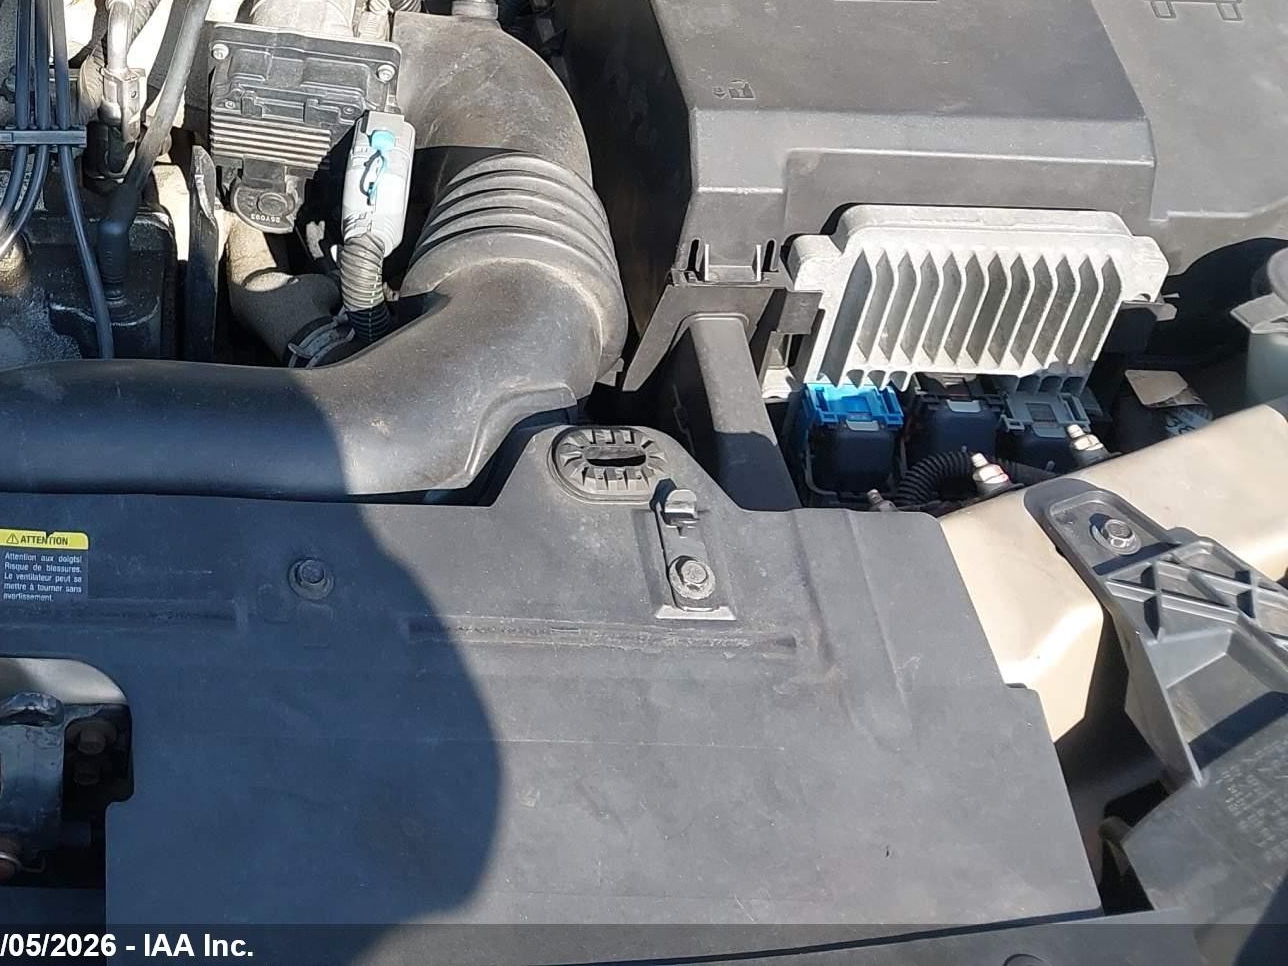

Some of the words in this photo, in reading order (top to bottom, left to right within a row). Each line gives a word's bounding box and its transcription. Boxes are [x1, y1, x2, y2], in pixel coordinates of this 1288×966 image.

[20, 534, 69, 546] ATTENTION
[4, 551, 37, 562] Attention
[40, 555, 54, 563] aux
[4, 561, 29, 572] Risque
[32, 563, 42, 572] de
[45, 564, 82, 573] blessures.
[3, 571, 13, 580] Le
[15, 572, 53, 582] ventilateur
[55, 575, 71, 584] peut
[3, 582, 27, 591] mettre
[37, 583, 64, 592] tourner
[65, 585, 82, 593] sans
[3, 592, 55, 602] avertissement.
